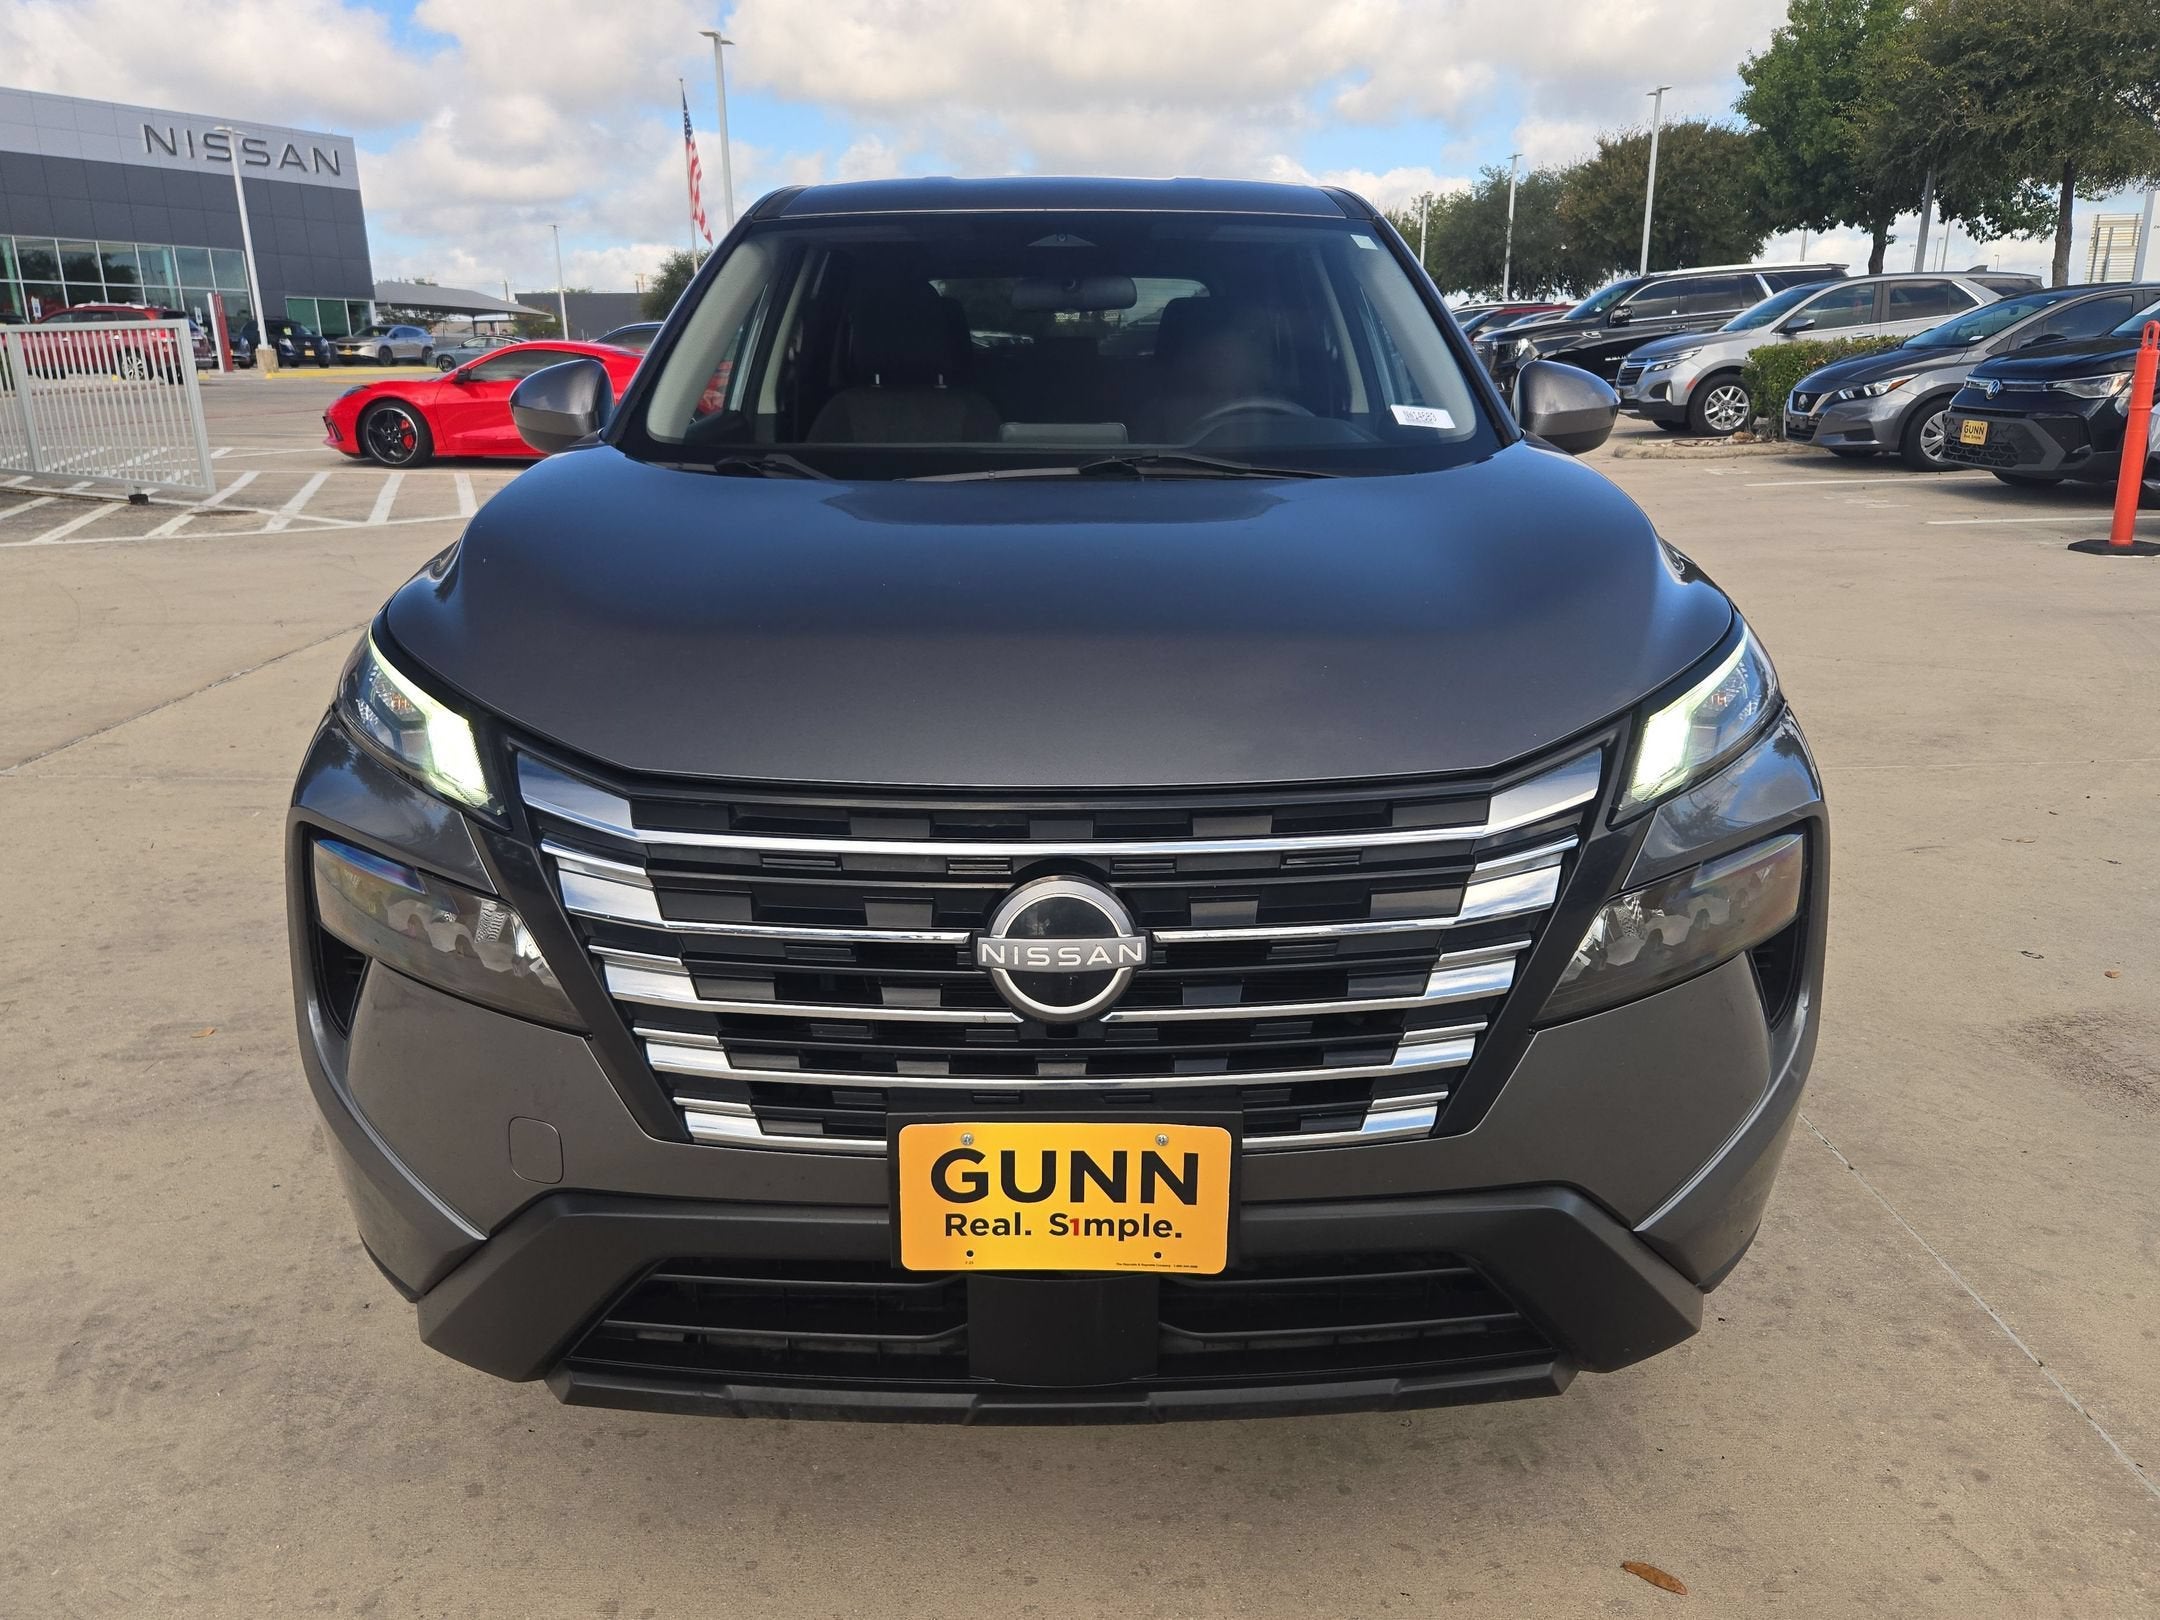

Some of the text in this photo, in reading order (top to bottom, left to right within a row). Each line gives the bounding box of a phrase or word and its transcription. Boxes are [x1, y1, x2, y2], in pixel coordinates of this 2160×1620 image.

[142, 123, 342, 176] NISSAN
[1963, 425, 1985, 436] GUNN
[981, 943, 1143, 966] NISSAN
[930, 1147, 1199, 1206] GUNN
[945, 1212, 1032, 1237] Real.
